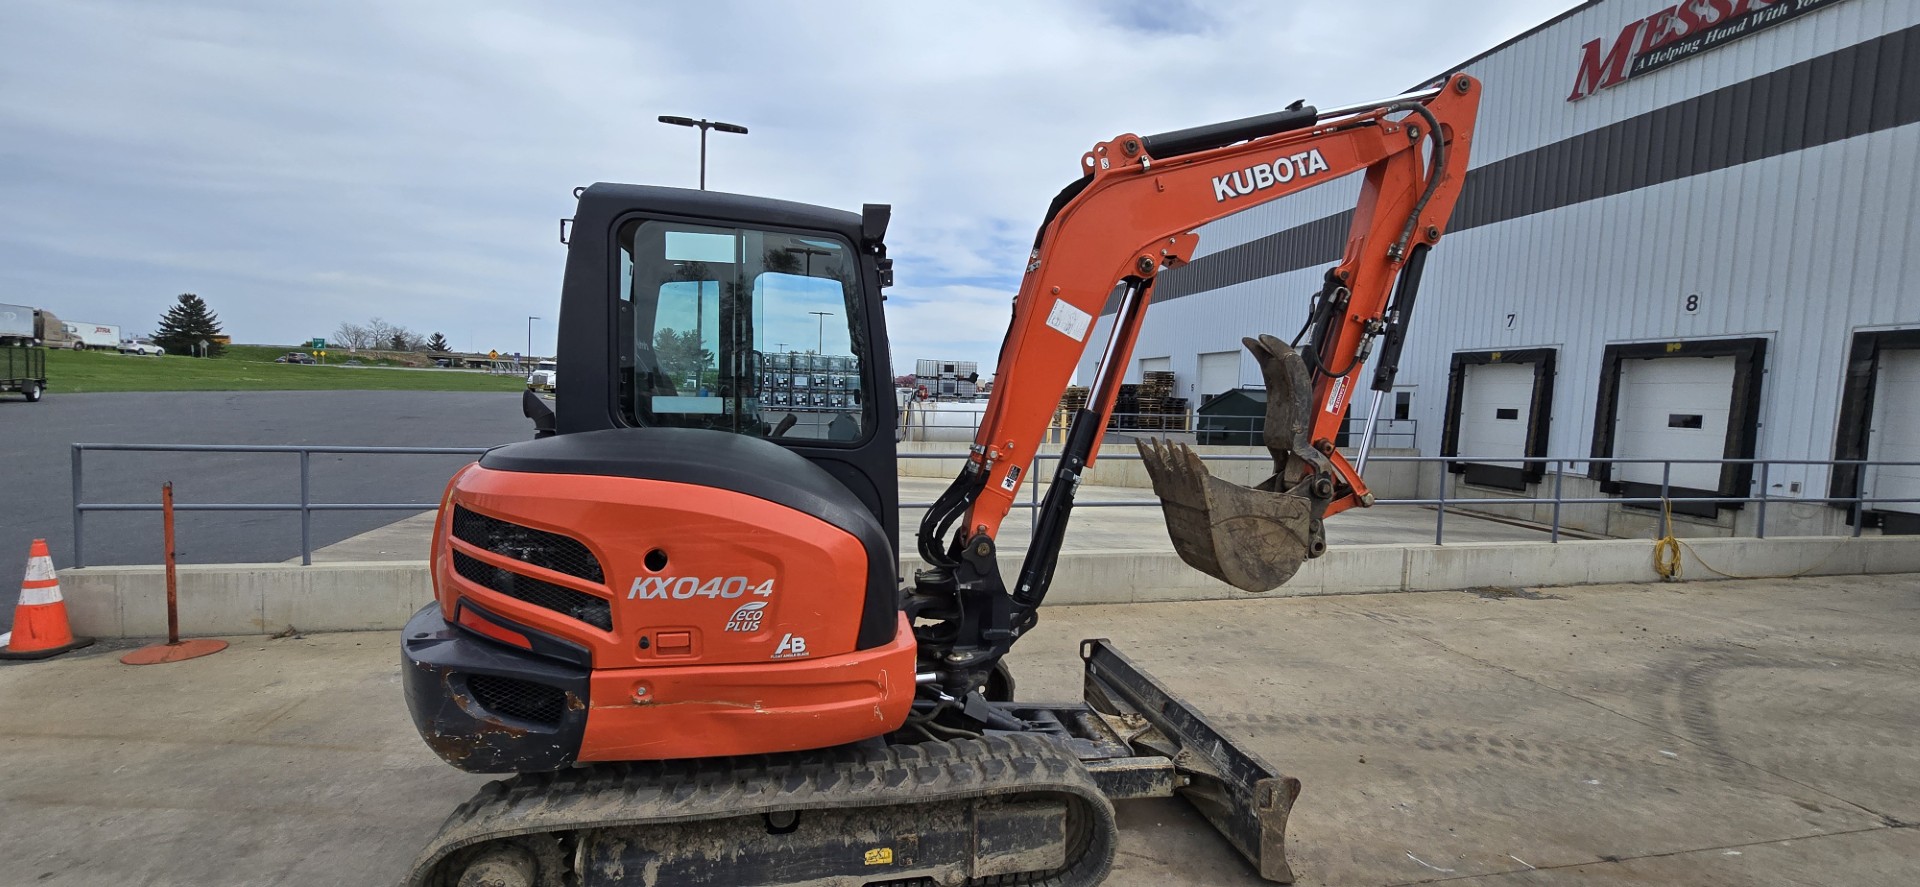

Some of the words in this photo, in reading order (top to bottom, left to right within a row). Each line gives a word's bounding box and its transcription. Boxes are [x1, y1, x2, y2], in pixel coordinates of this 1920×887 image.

[1635, 59, 1648, 70] A
[1647, 39, 1700, 66] Helping
[1705, 18, 1748, 45] Hand
[1752, 2, 1788, 27] With
[1796, 0, 1820, 10] Yo
[1212, 148, 1329, 202] KUBOTA
[1686, 294, 1699, 311] 8
[1507, 314, 1516, 327] 7
[627, 576, 775, 600] KX040-4
[736, 610, 764, 621] eco
[724, 621, 761, 632] PLUS
